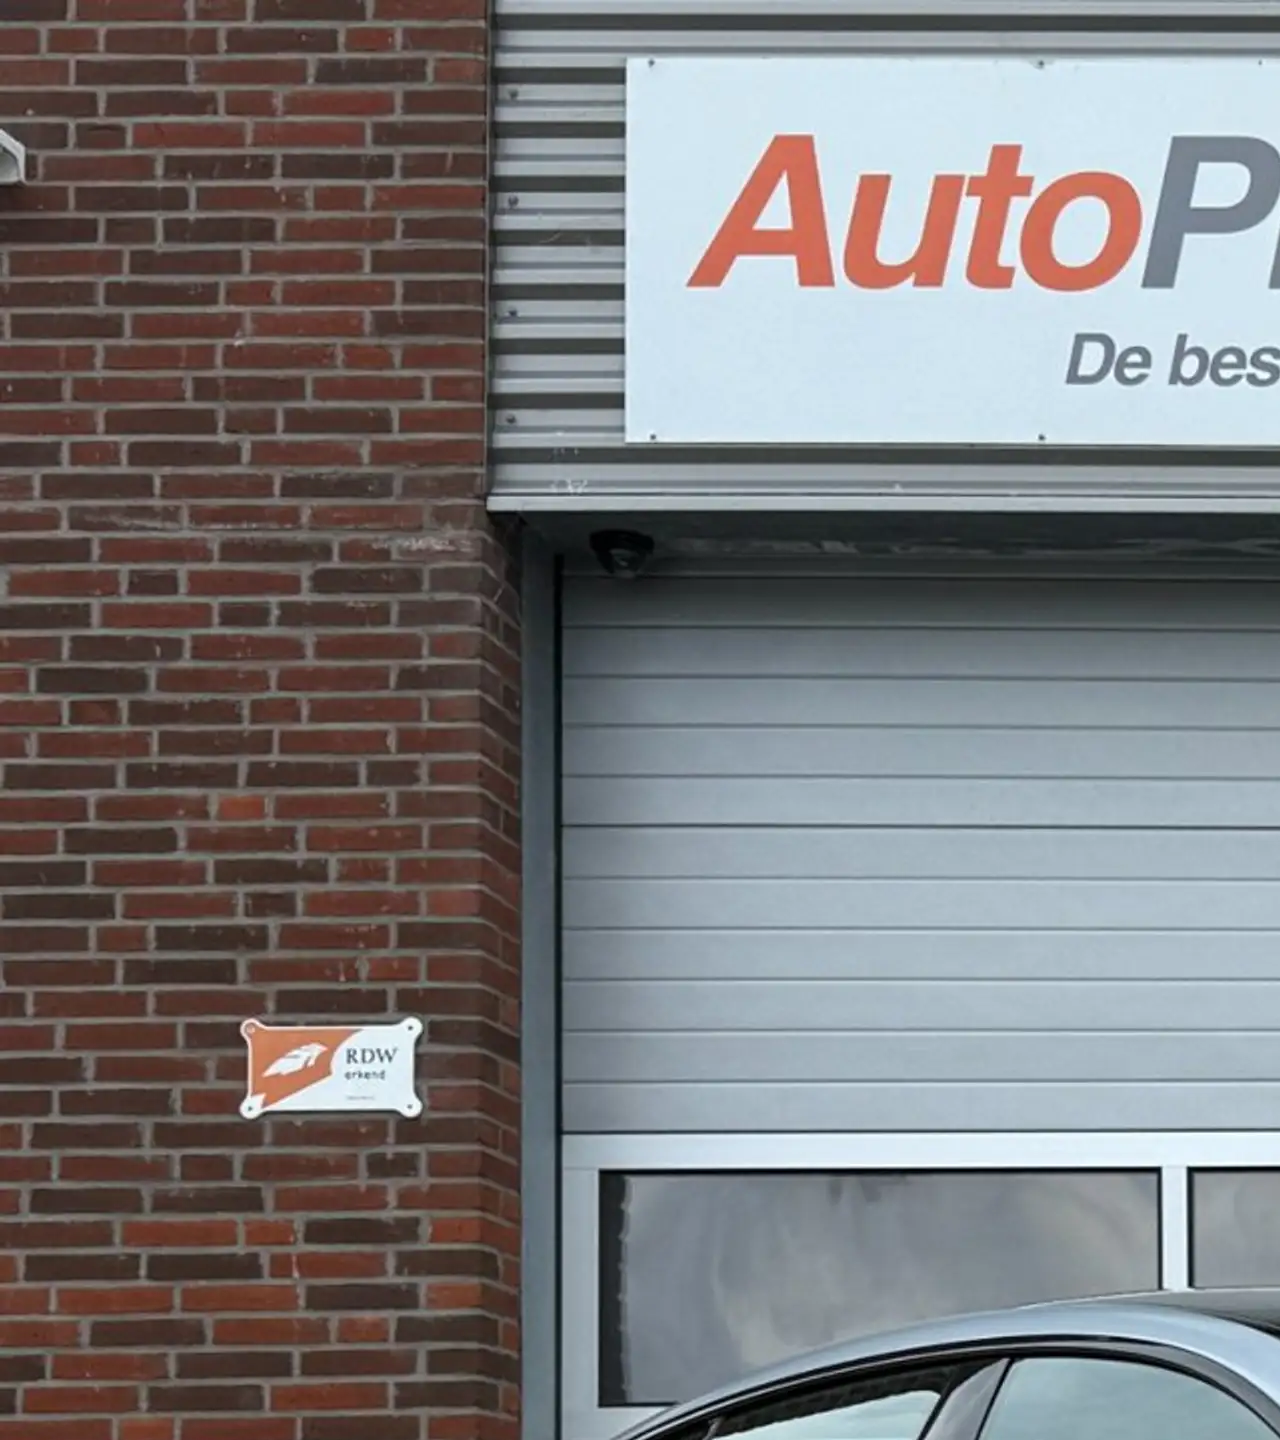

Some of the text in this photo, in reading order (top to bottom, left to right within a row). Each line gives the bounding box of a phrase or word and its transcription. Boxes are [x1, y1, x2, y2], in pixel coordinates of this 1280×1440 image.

[1065, 332, 1152, 386] De
[346, 1048, 398, 1064] RDW
[345, 1070, 386, 1080] erkend
